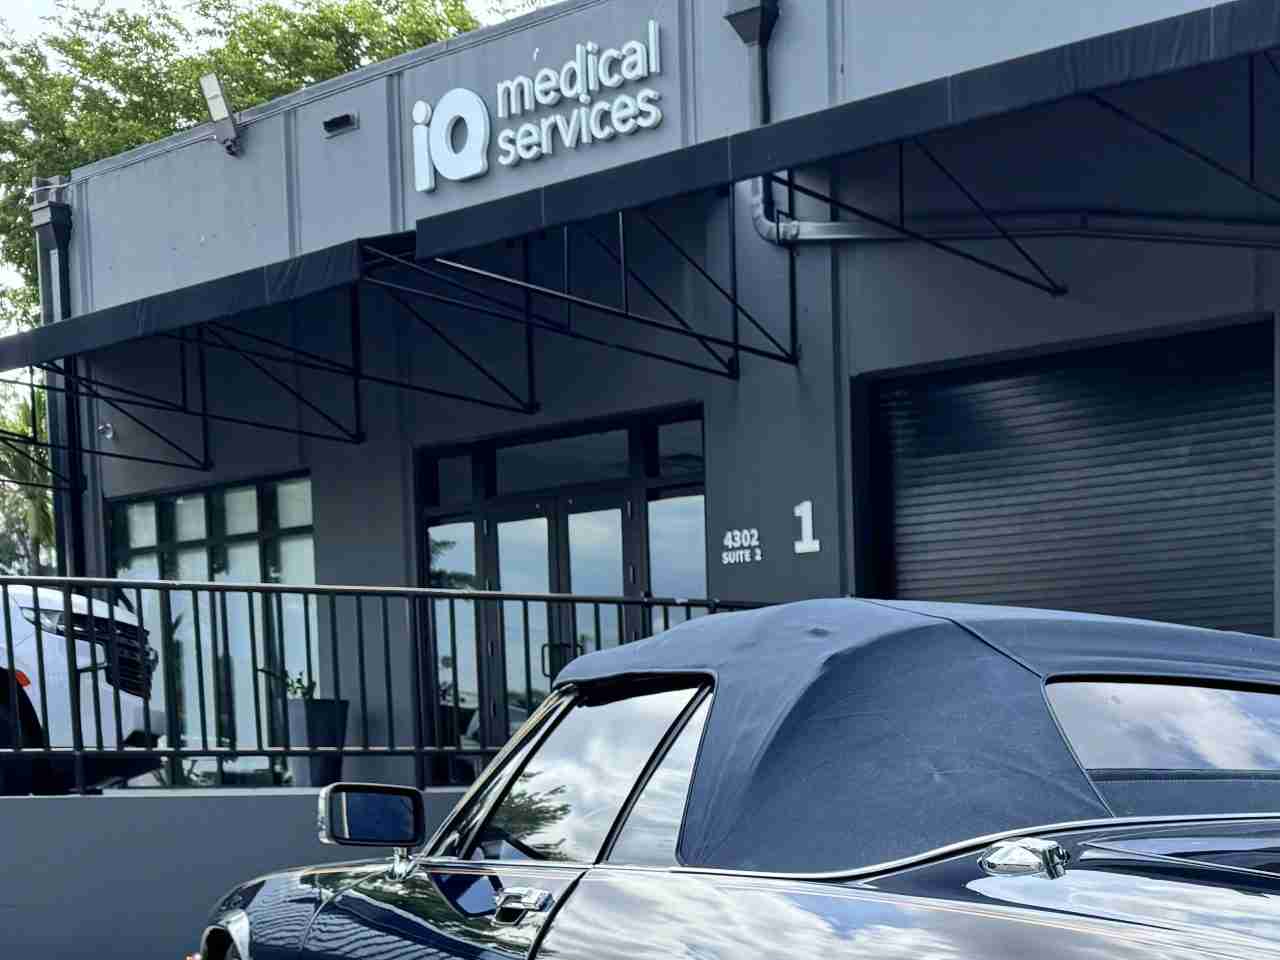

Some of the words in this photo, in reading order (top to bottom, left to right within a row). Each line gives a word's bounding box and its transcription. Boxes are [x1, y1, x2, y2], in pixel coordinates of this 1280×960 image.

[497, 19, 661, 118] medical
[497, 88, 664, 167] services
[723, 528, 760, 549] 4302
[793, 500, 821, 554] 1
[721, 549, 752, 565] SUITE
